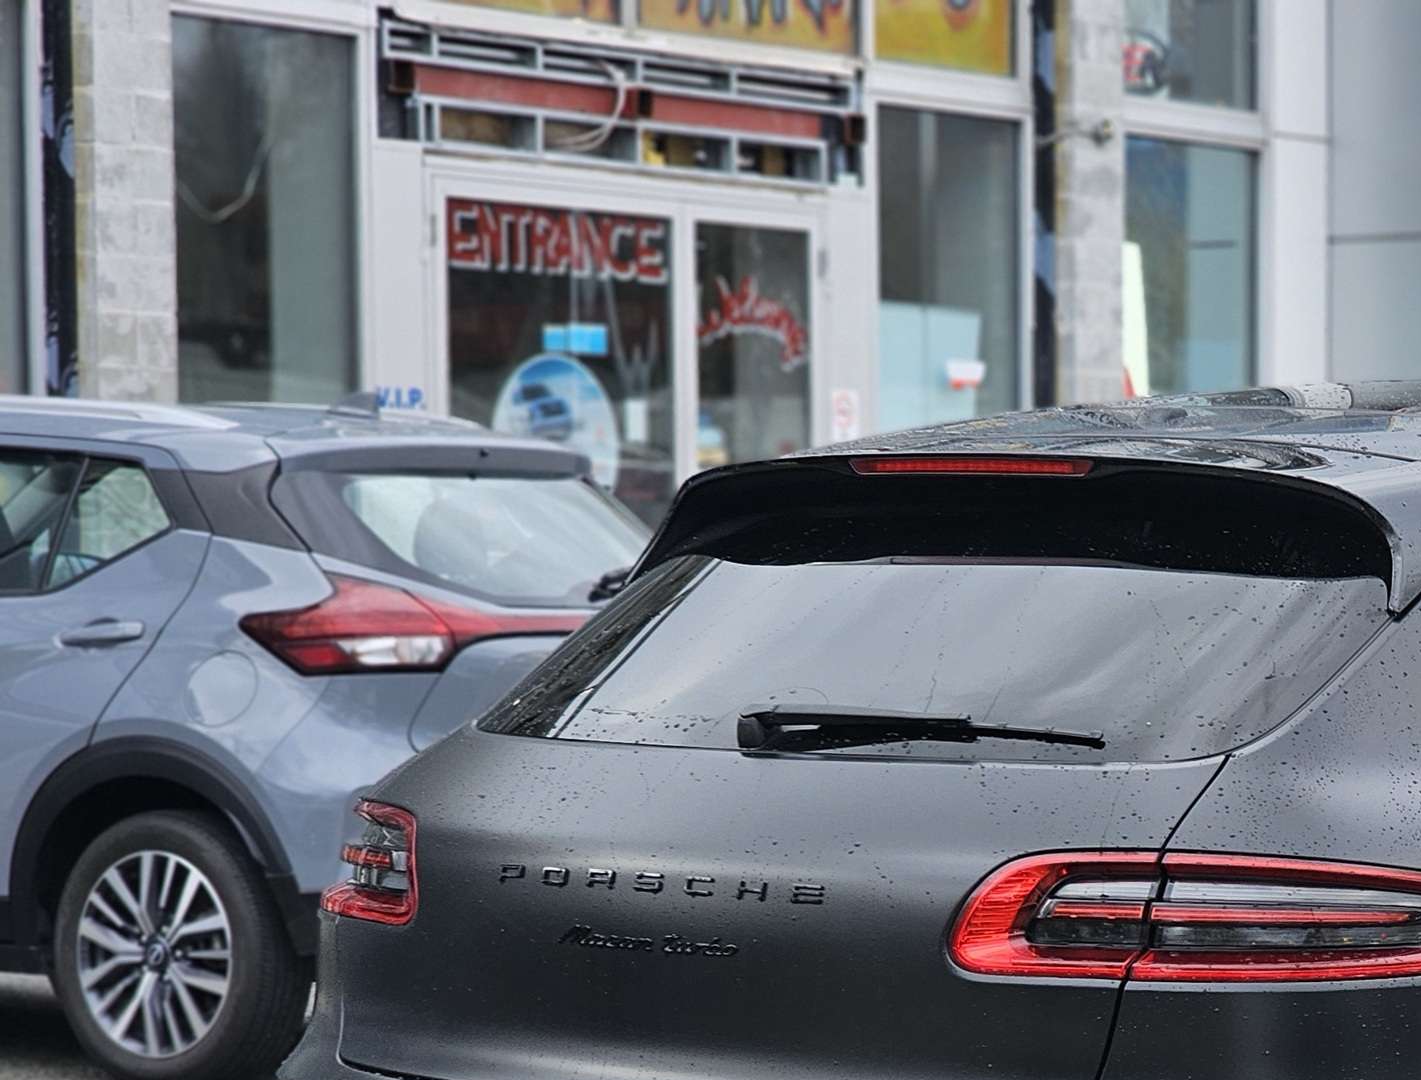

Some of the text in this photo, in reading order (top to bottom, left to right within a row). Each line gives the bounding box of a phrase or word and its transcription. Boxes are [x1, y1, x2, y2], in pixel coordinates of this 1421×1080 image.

[447, 202, 669, 285] ENTRANCE
[499, 863, 826, 905] PORSCHE
[557, 922, 654, 951] Macan
